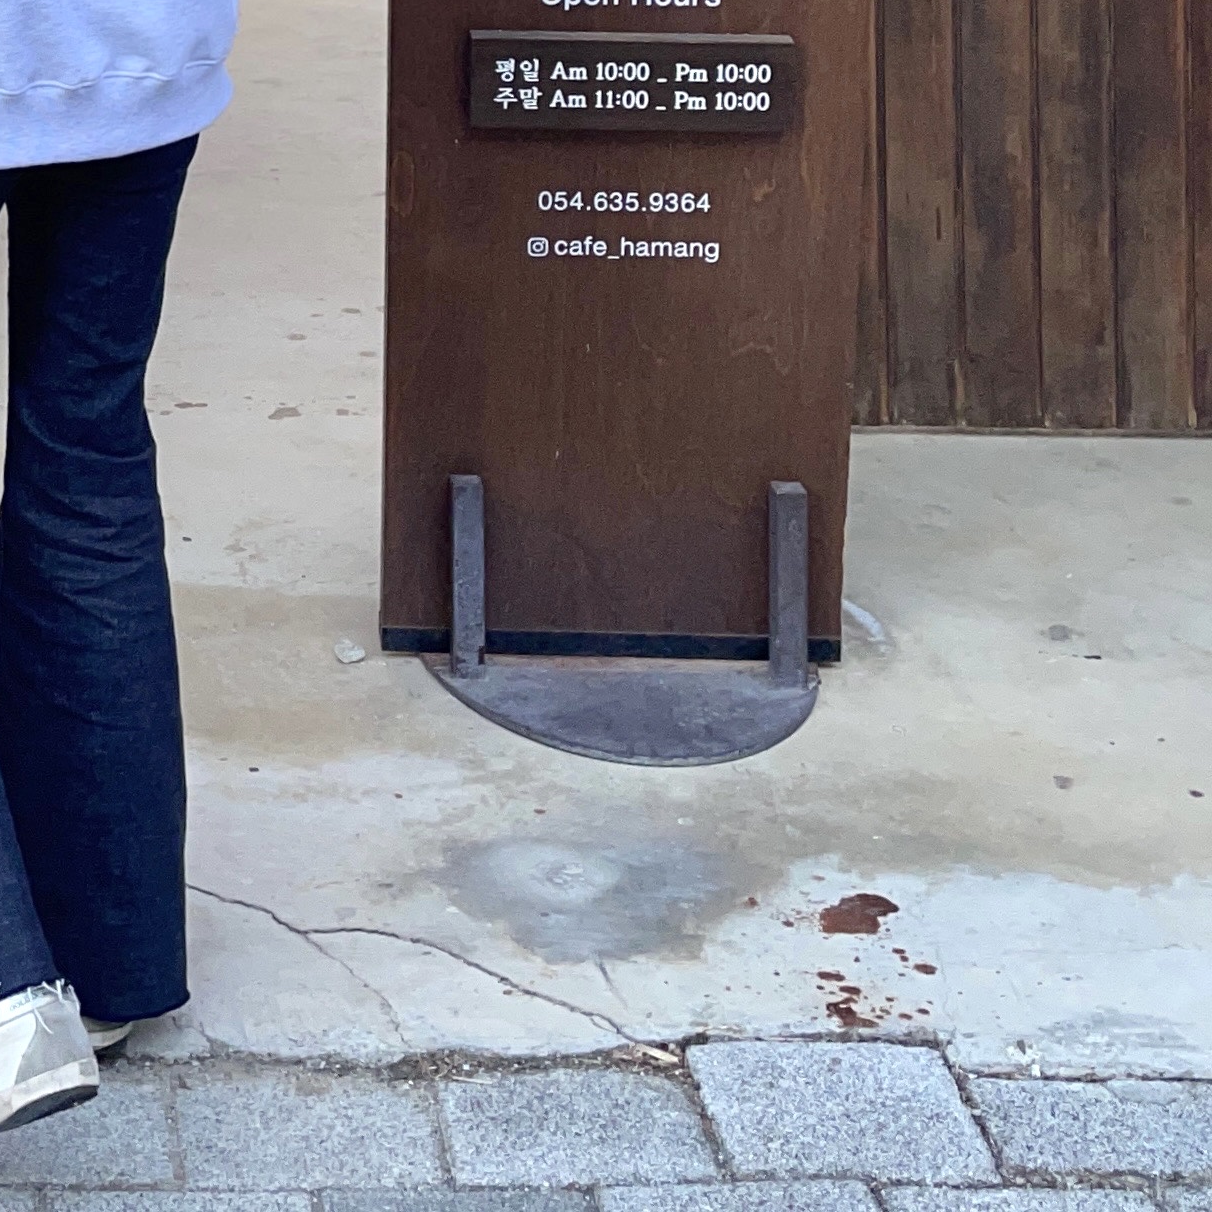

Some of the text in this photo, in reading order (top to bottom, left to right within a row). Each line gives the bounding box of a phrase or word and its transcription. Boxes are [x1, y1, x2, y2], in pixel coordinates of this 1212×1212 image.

[495, 58, 540, 82] 평일
[549, 61, 588, 81] Am
[595, 62, 650, 82] 10:00
[674, 63, 709, 83] Pm
[715, 63, 772, 84] 10:00
[493, 86, 543, 110] 주말
[549, 89, 588, 109] Am
[594, 89, 649, 110] 11:00
[673, 90, 708, 111] Pm
[714, 91, 771, 112] 10:00
[538, 190, 711, 213] 054.635.9364
[554, 235, 720, 264] cafe_hamang
